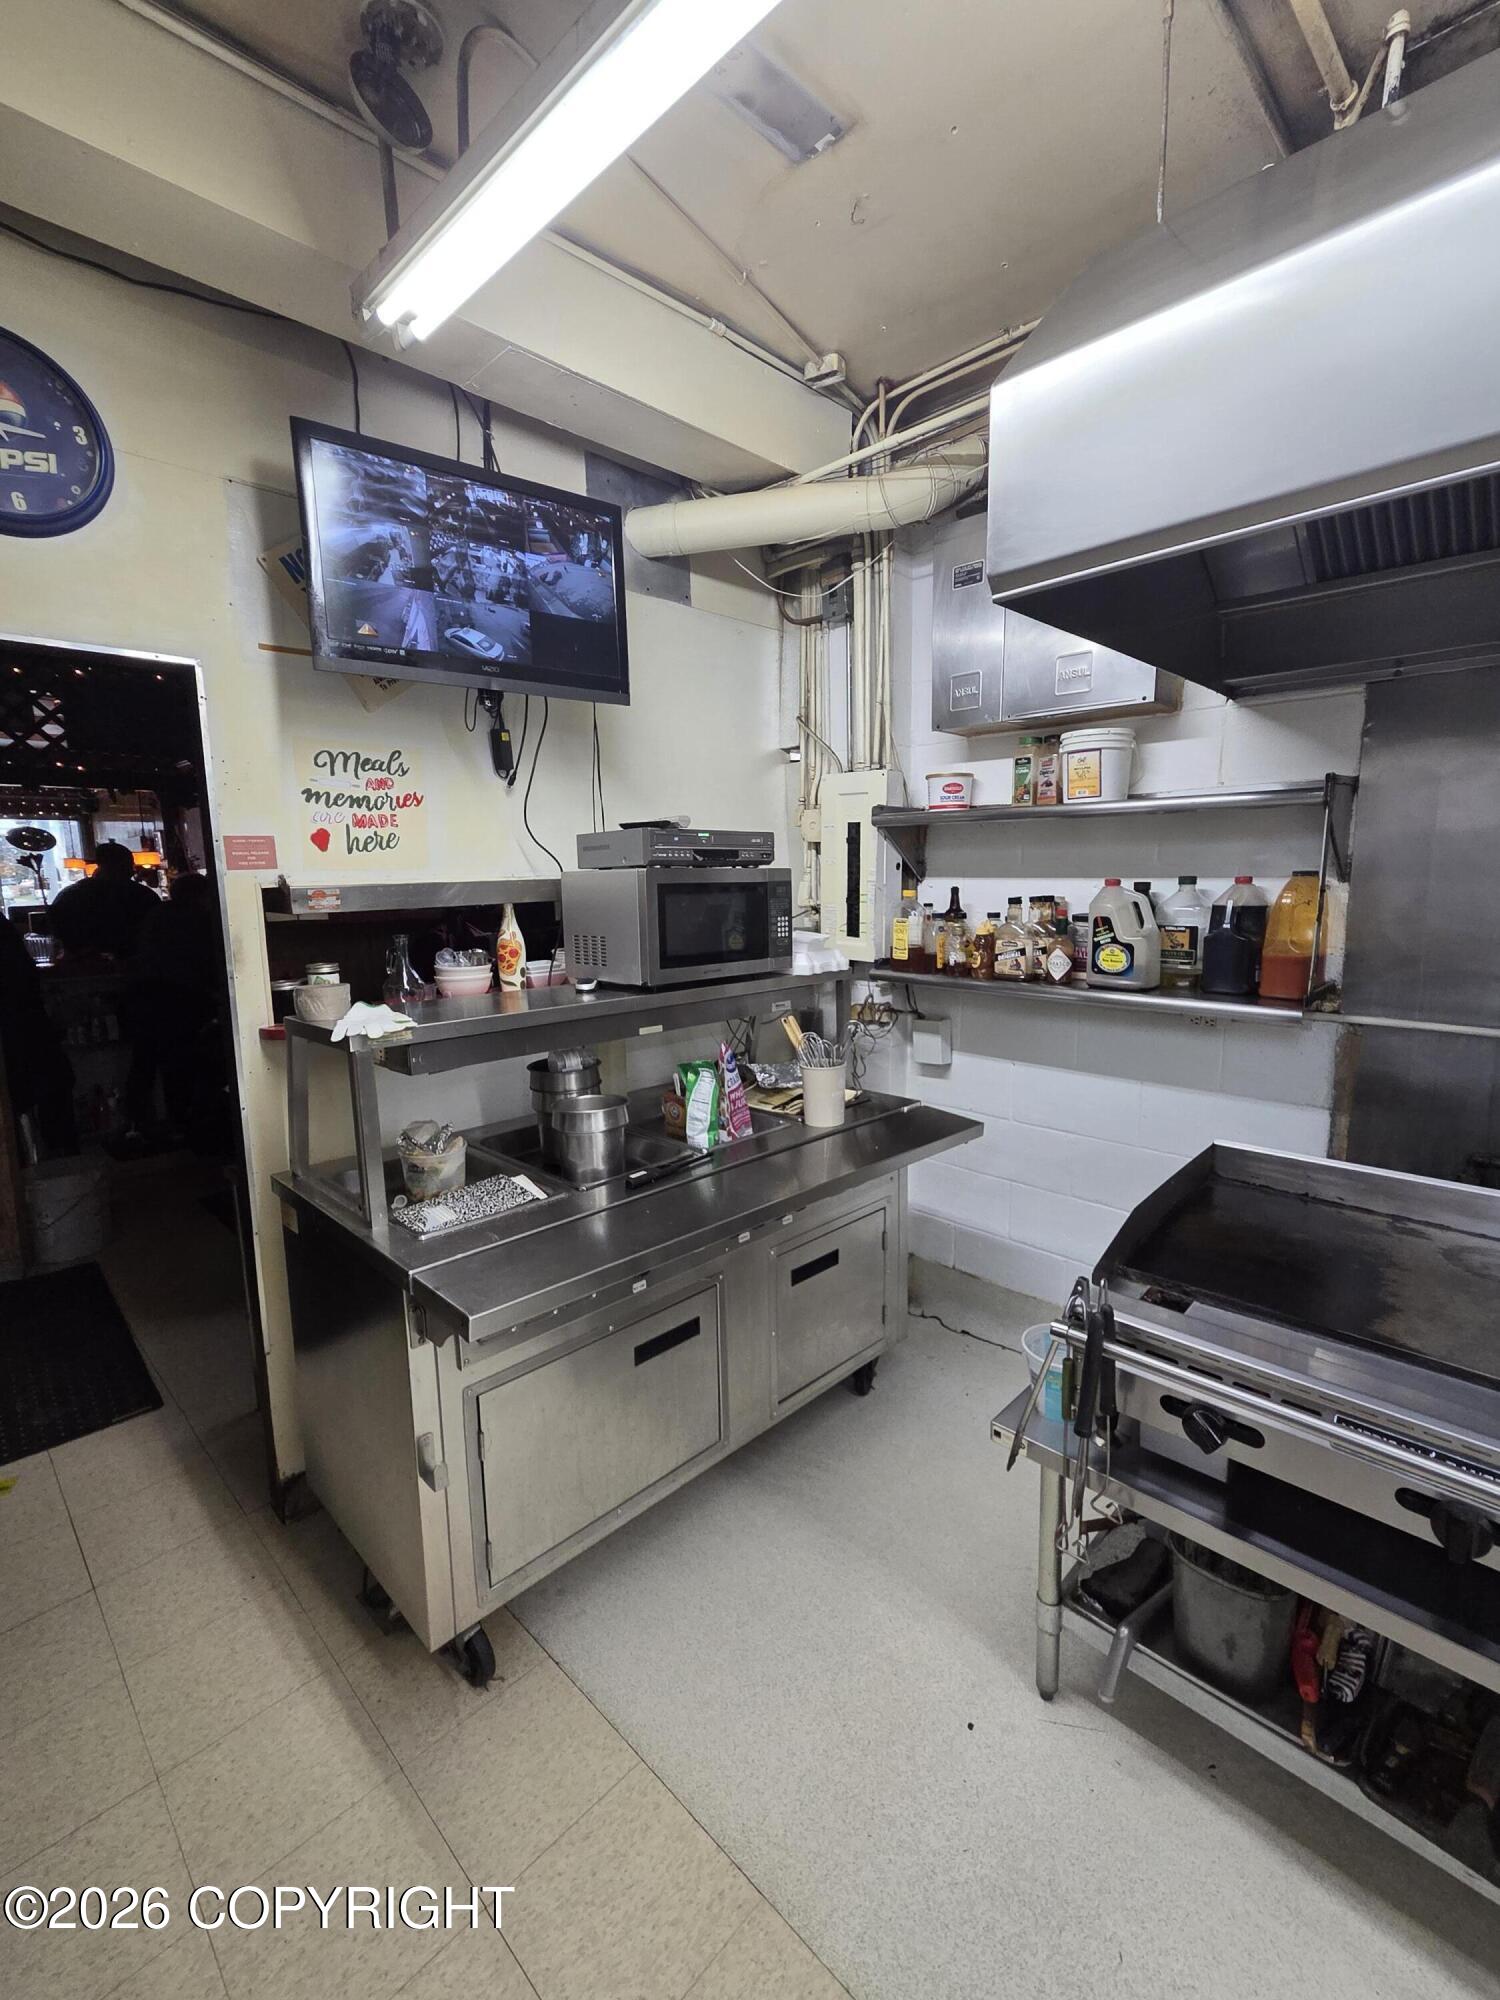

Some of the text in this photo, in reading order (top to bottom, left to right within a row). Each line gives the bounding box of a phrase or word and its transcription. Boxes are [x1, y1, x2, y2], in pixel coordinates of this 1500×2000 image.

[72, 425, 89, 446] 3
[11, 491, 28, 511] 6
[313, 749, 410, 780] Meals
[365, 776, 395, 791] AND
[301, 787, 424, 812] memories
[352, 813, 399, 829] MADE
[346, 823, 400, 855] here
